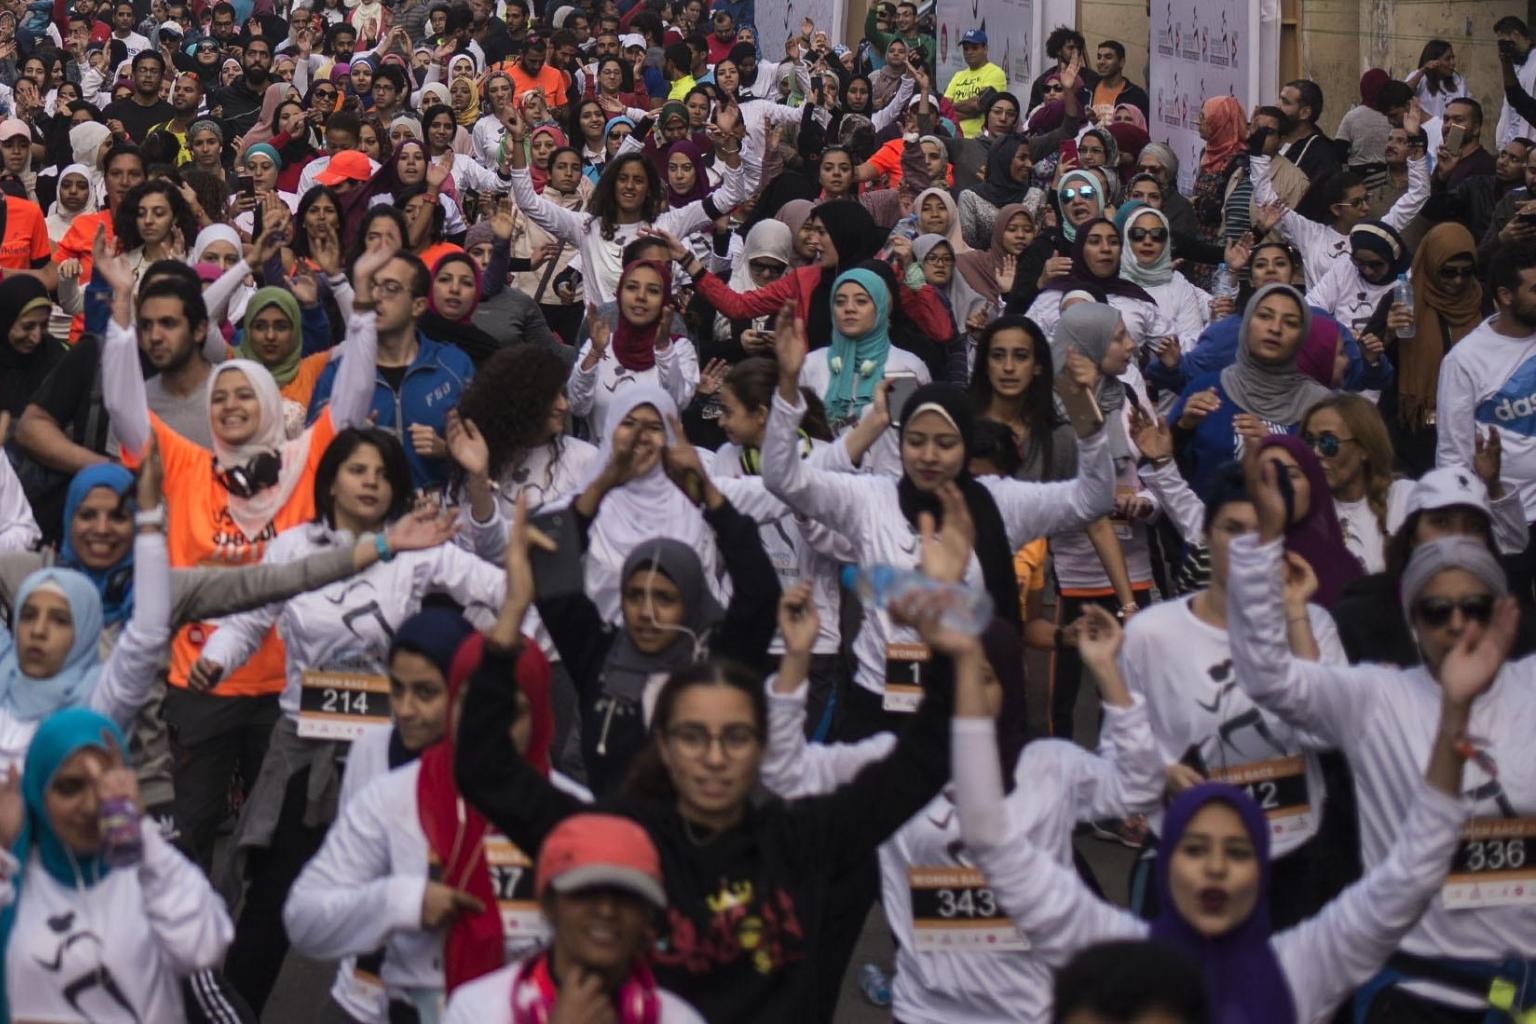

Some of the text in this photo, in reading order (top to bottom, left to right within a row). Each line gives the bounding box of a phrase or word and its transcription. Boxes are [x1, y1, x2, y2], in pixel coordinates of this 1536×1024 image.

[322, 688, 368, 714] 214
[1467, 840, 1526, 871] 336
[937, 889, 996, 917] 343
